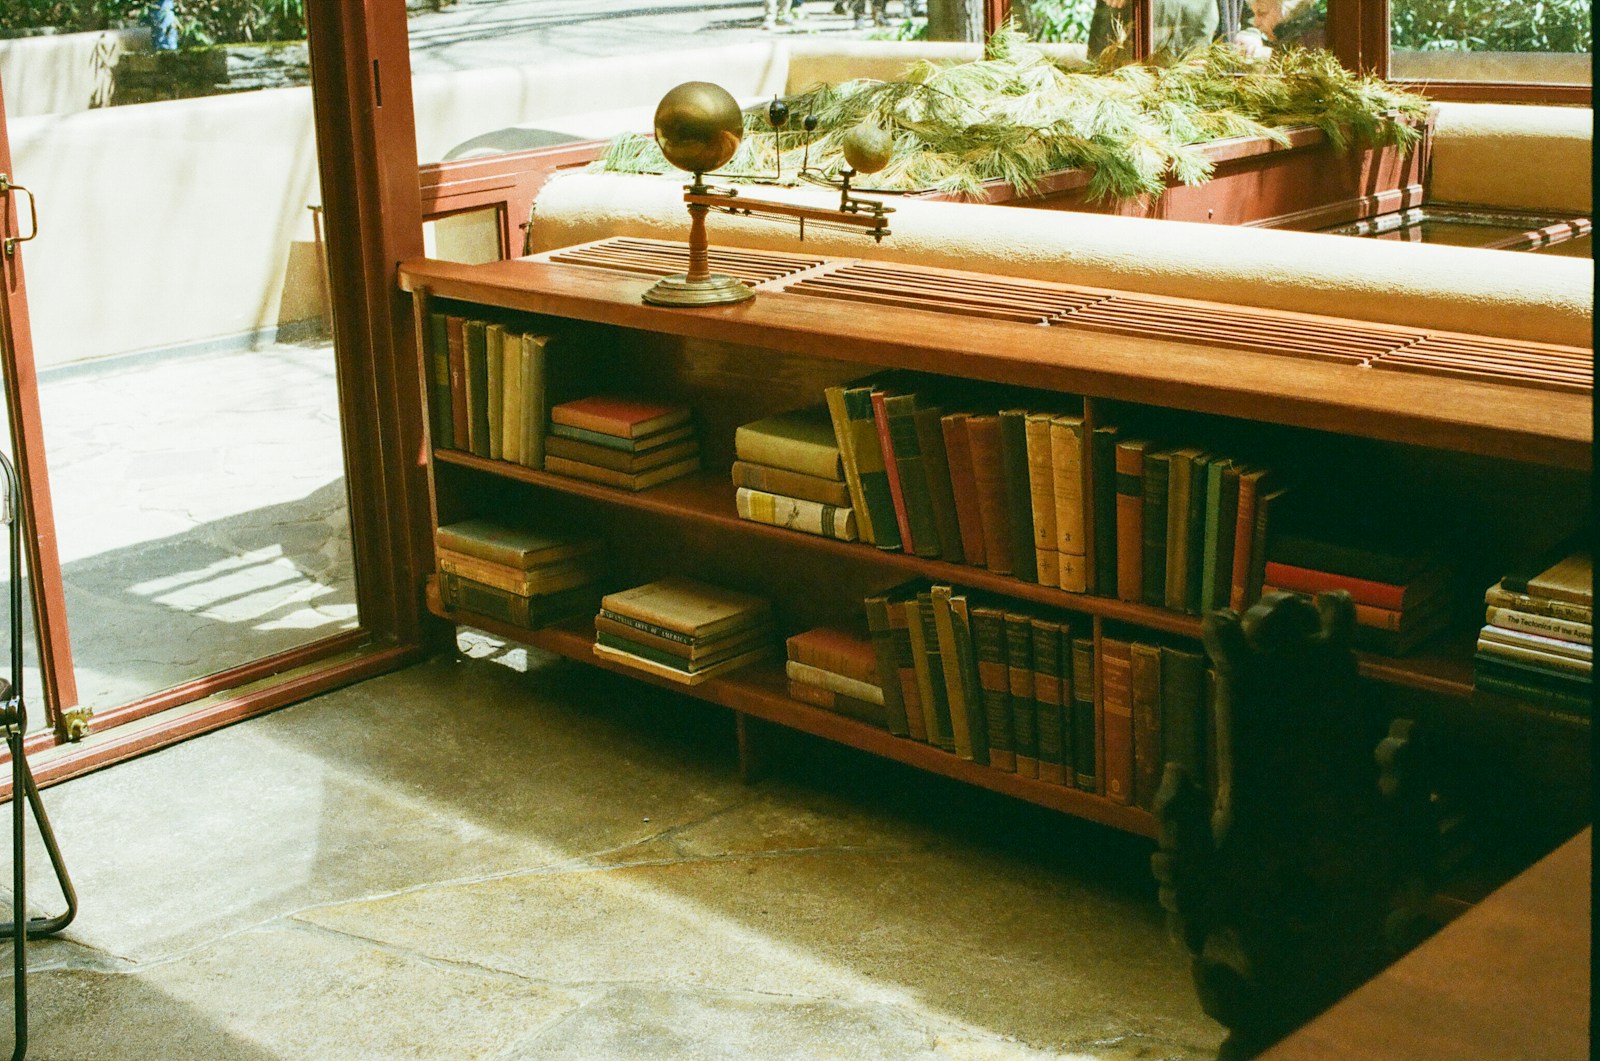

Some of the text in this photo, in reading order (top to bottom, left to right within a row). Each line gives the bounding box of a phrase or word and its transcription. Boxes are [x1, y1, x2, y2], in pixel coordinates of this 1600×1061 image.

[1041, 529, 1046, 538] 2
[1065, 533, 1071, 542] 3
[1508, 615, 1519, 624] The
[1521, 618, 1552, 631] Tectonics
[1553, 625, 1561, 633] of
[634, 622, 648, 631] ARTS
[650, 627, 657, 635] OF
[661, 630, 687, 644] AMERICA
